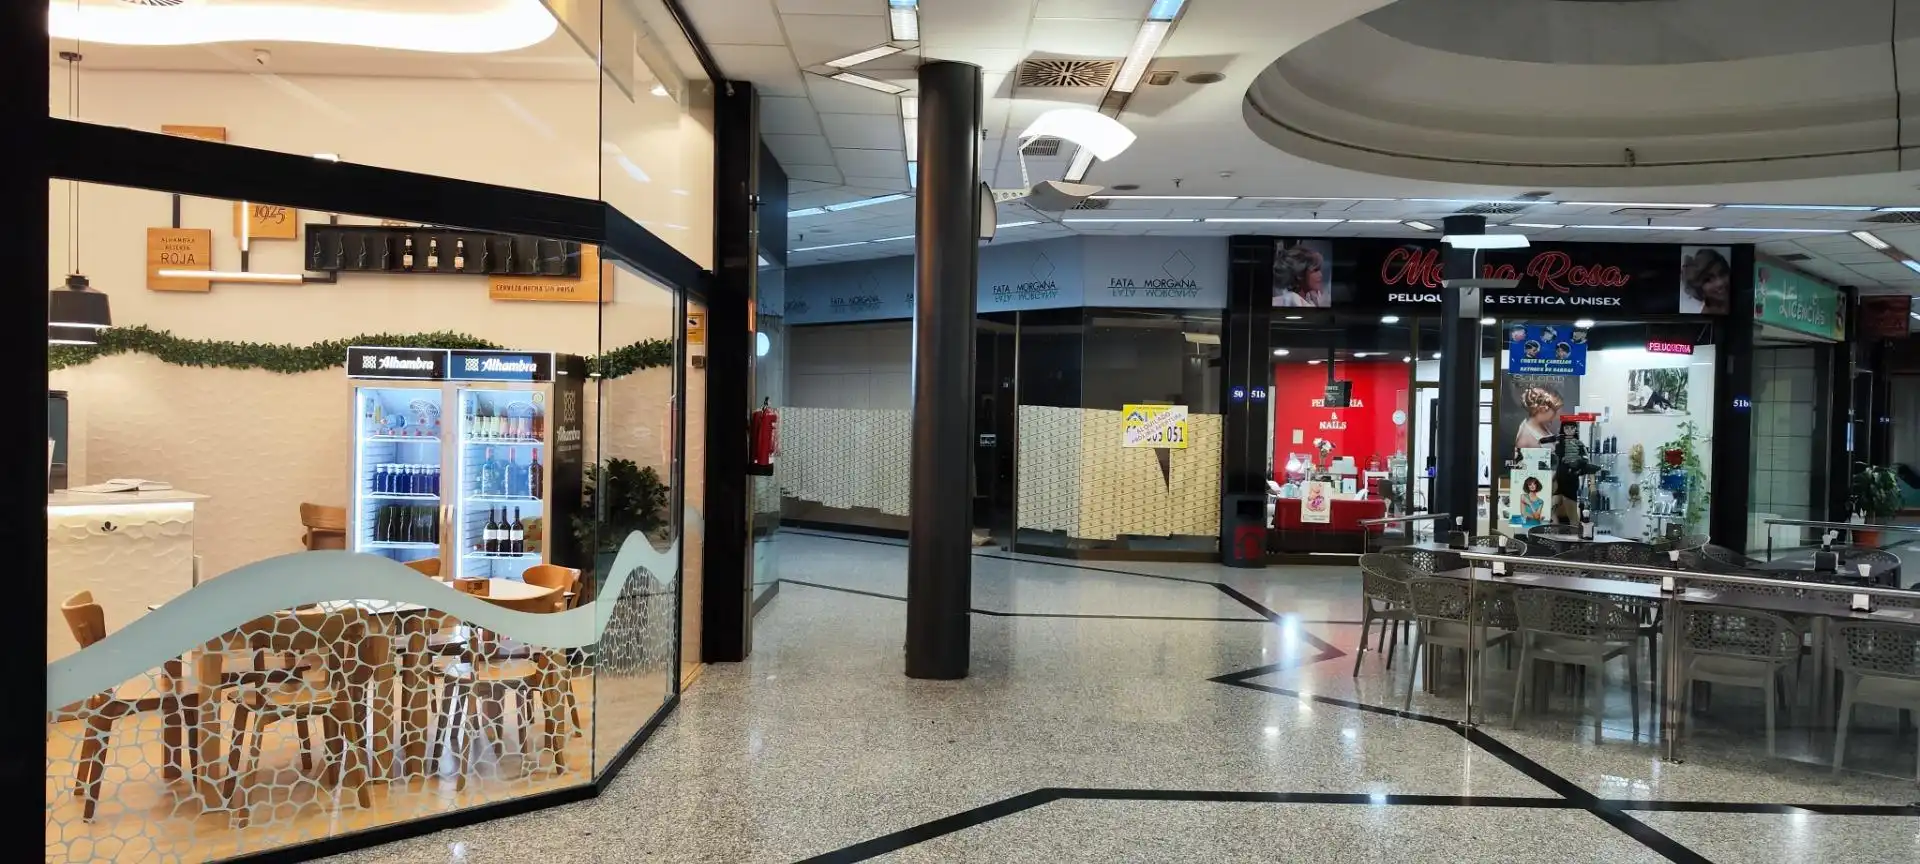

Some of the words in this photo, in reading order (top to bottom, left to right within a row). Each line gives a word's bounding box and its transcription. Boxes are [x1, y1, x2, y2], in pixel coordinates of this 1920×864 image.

[253, 204, 286, 224] 1925
[160, 252, 196, 265] ROJA
[1527, 251, 1630, 294] Rosa
[993, 284, 1011, 294] FATA
[1016, 280, 1056, 291] MORGANA
[1110, 278, 1134, 287] FATA
[1144, 279, 1197, 288] MORGANA
[1388, 293, 1442, 302] PELUQ
[1484, 295, 1495, 304] &
[1499, 293, 1565, 305] ESTÉTICA
[1570, 296, 1621, 306] UNISEX
[1649, 342, 1691, 353] PELUQUERIA
[379, 355, 434, 370] Alhambra
[481, 358, 537, 373] Alhambra
[1233, 390, 1244, 398] 50
[1250, 390, 1266, 398] 51b
[1732, 399, 1749, 407] 51b
[1331, 411, 1338, 420] &
[1319, 421, 1347, 430] NAILS
[1167, 426, 1184, 442] 051
